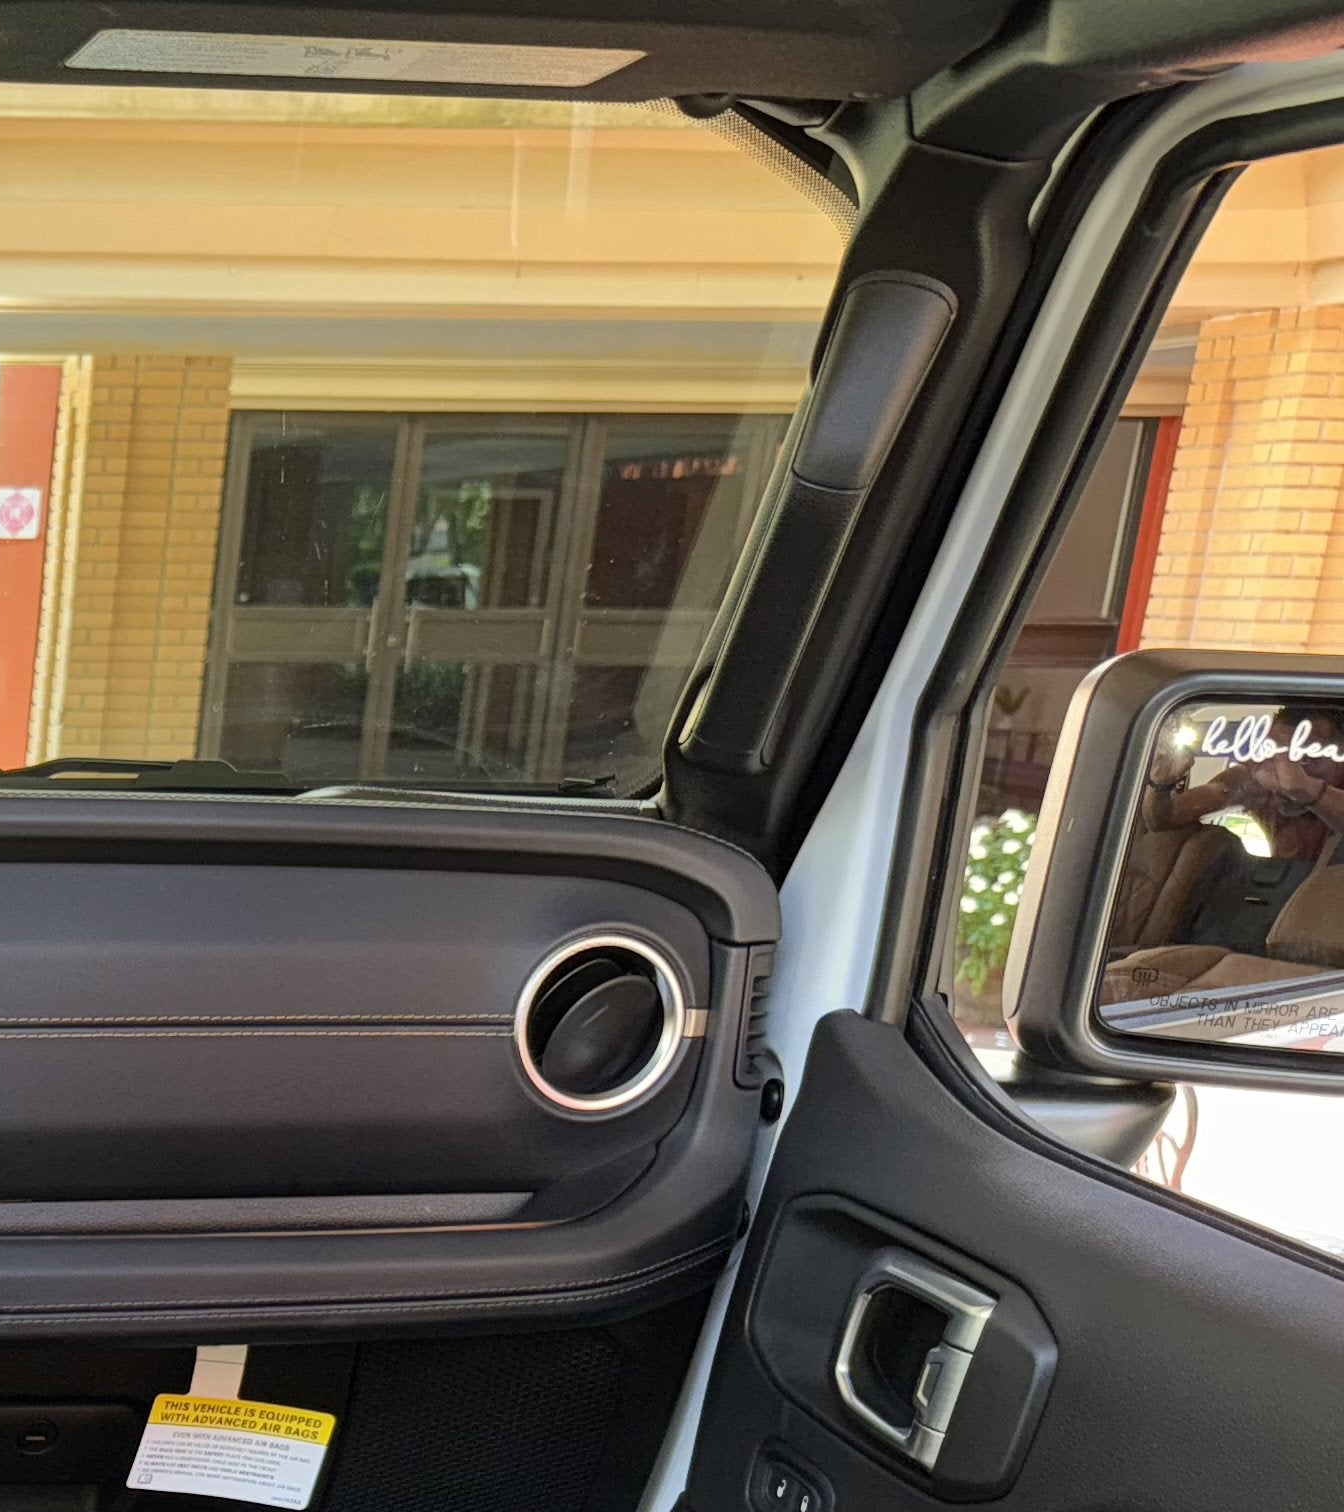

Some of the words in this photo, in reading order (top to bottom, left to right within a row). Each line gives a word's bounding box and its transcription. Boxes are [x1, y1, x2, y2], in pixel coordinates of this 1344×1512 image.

[1202, 715, 1289, 763] hello
[1149, 995, 1217, 1012] OBJECTS
[1223, 1001, 1238, 1011] IN
[1245, 1001, 1300, 1018] MIRROR
[1305, 1005, 1339, 1021] ARE
[1196, 1013, 1237, 1029] THAN
[1244, 1017, 1281, 1031] THEY
[160, 1411, 189, 1423] WITH
[191, 1413, 257, 1430] ADVANCED
[260, 1421, 282, 1434] AIR
[284, 1424, 320, 1441] BAGS
[163, 1400, 190, 1412] THIS
[193, 1402, 241, 1417] VEHICLE
[244, 1408, 256, 1418] IS
[258, 1409, 323, 1430] EQUIPPED
